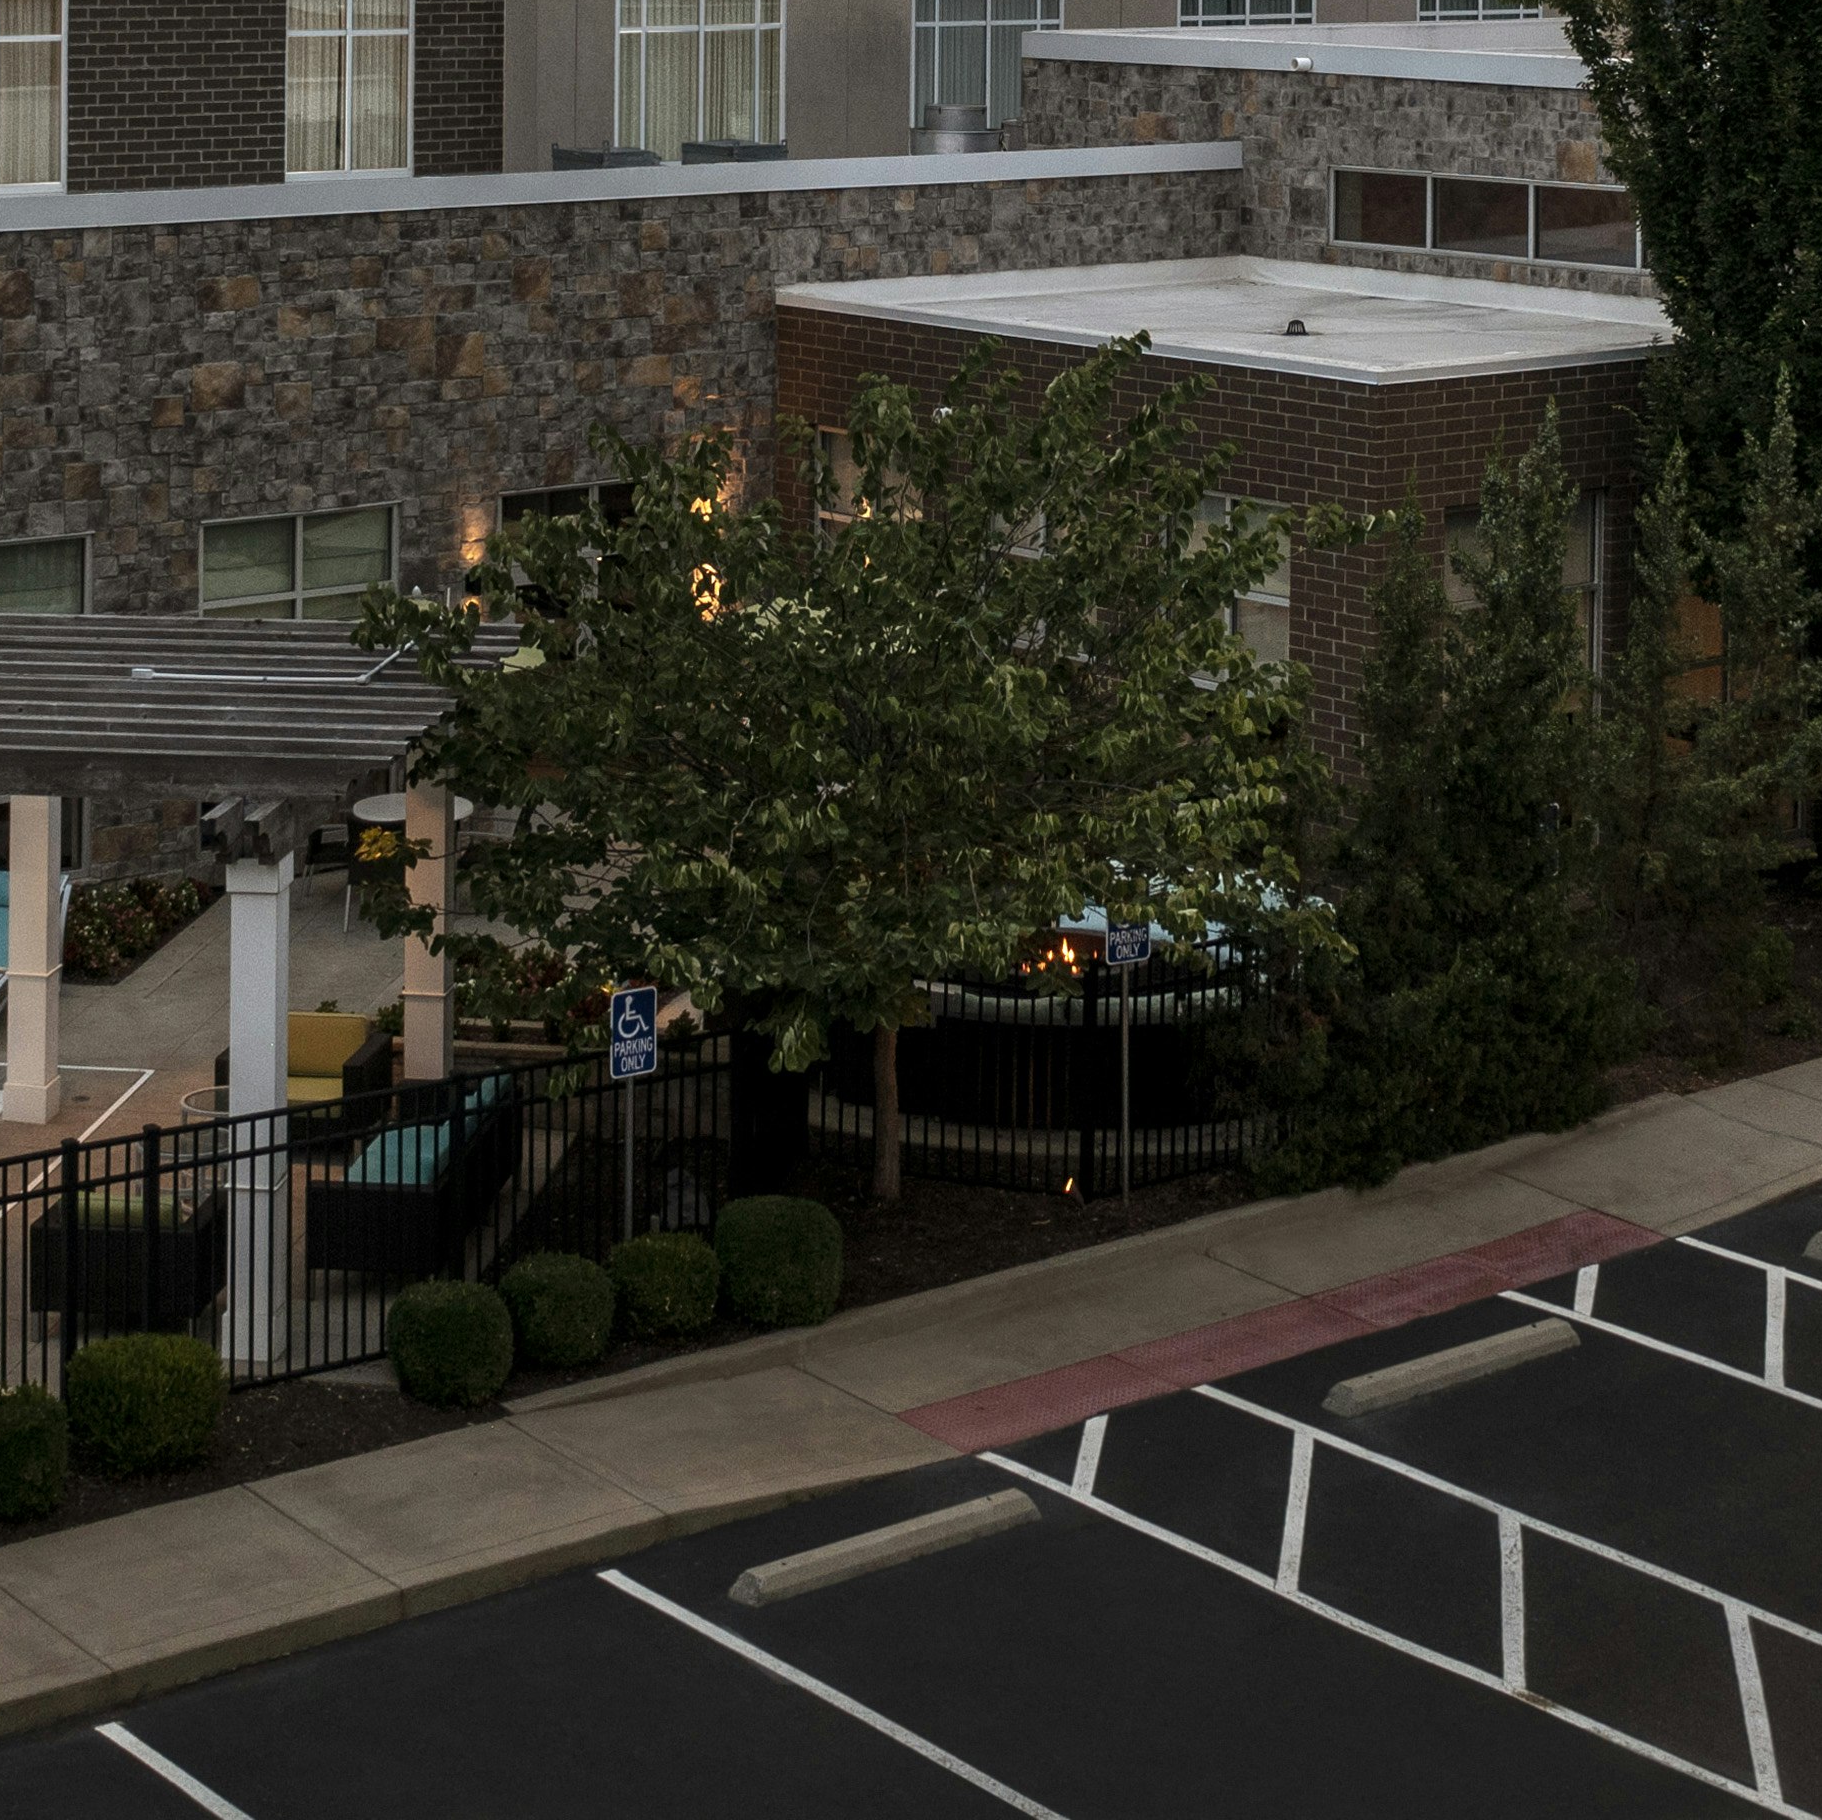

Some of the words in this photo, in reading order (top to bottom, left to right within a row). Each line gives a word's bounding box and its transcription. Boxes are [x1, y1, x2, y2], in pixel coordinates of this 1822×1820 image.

[1109, 927, 1147, 946] PARKING
[1116, 943, 1140, 959] ONLY
[614, 1037, 653, 1057] PARKING
[620, 1055, 646, 1072] ONLY
